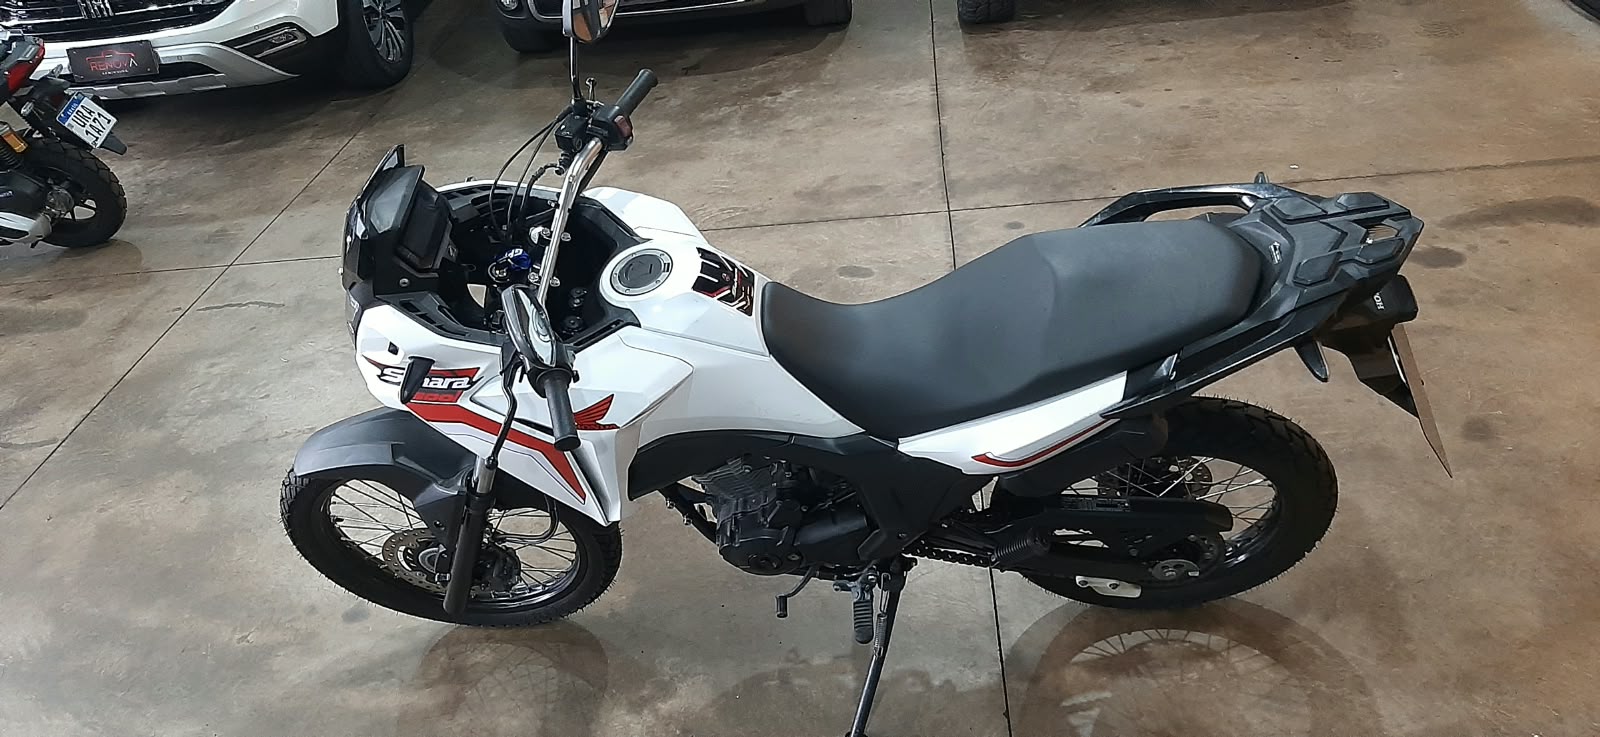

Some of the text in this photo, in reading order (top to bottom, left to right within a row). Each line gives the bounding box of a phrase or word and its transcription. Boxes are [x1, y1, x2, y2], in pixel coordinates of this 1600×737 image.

[72, 104, 95, 128] URA
[85, 112, 111, 141] 1A71
[379, 367, 472, 389] Sara
